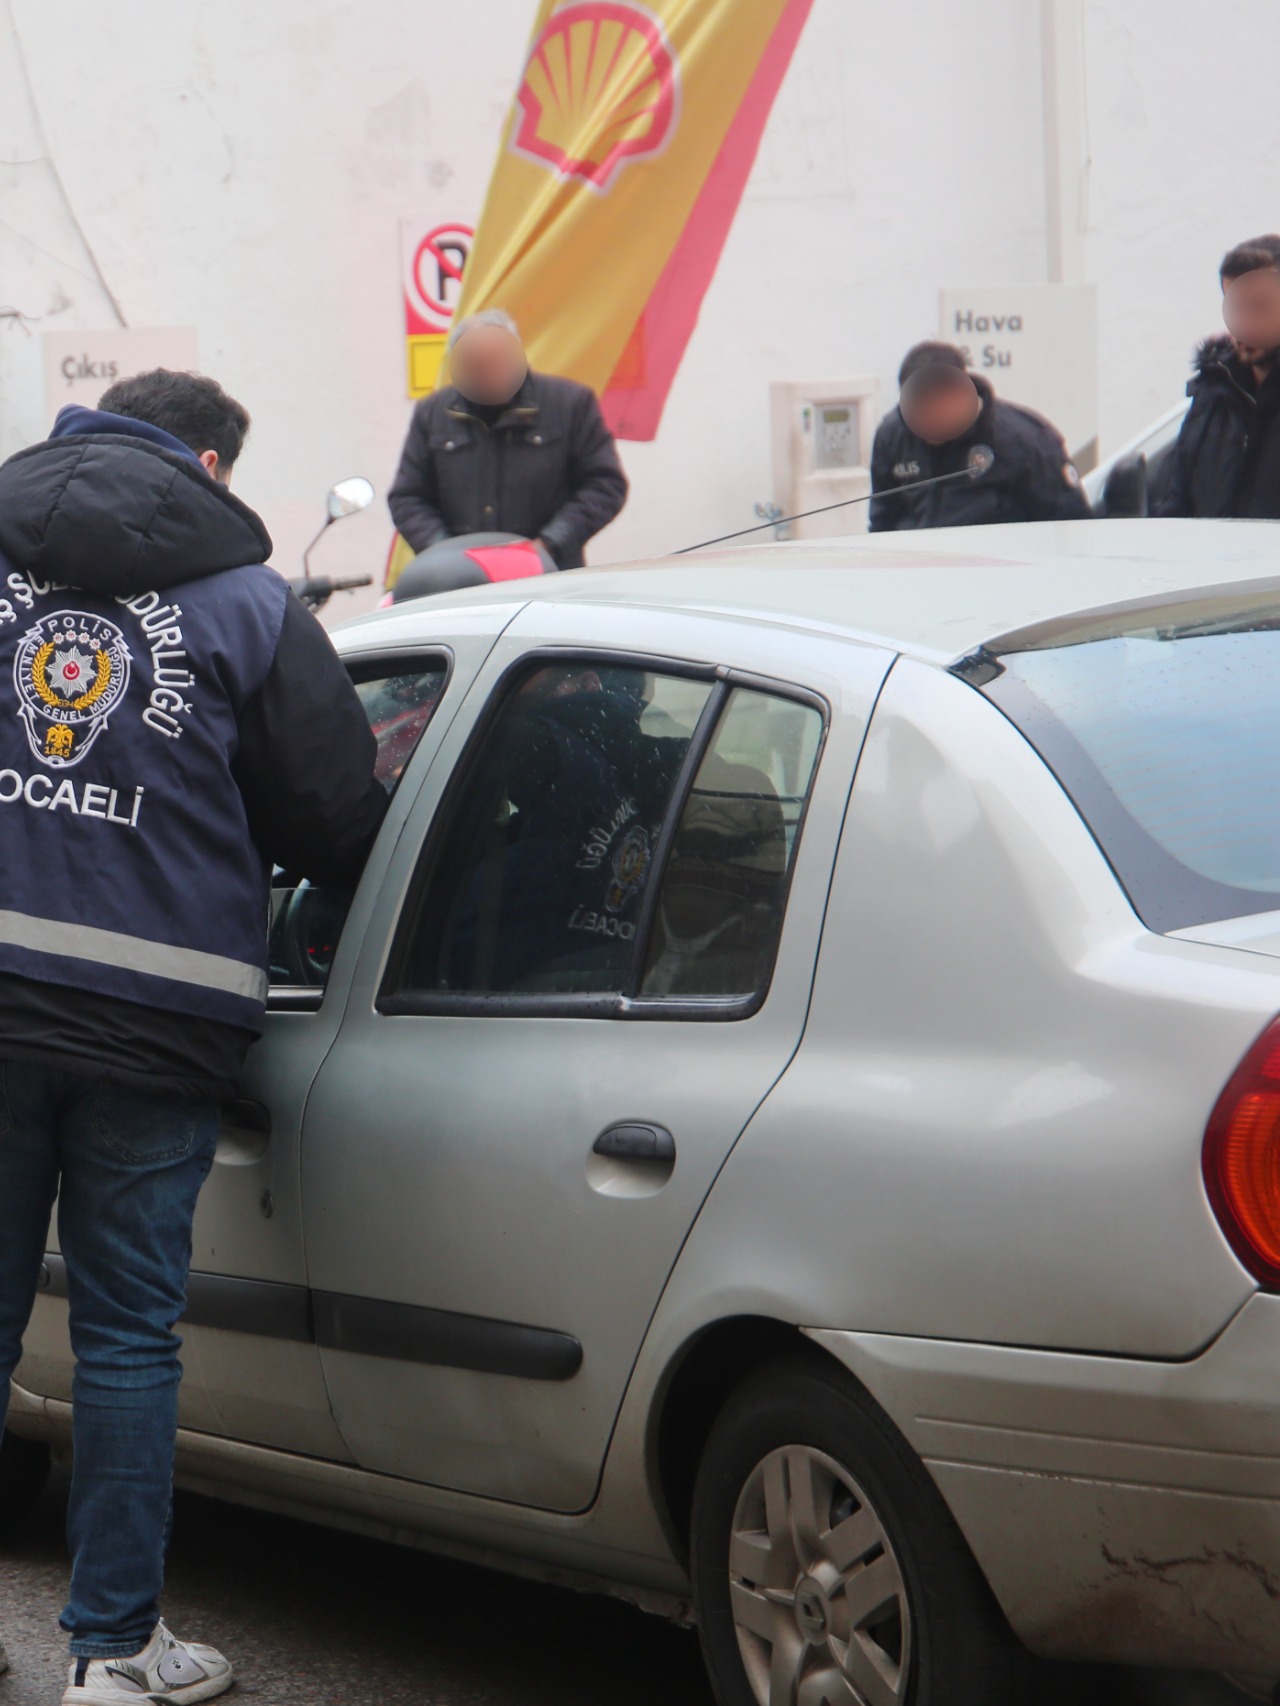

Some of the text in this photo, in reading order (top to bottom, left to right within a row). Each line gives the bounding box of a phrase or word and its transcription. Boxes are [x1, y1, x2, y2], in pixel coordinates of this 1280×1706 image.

[955, 309, 1023, 332] Hava
[982, 344, 1012, 367] Su
[61, 353, 119, 387] Çıkış
[47, 616, 112, 641] POLİS
[43, 704, 86, 721] GENEL
[44, 745, 70, 757] 1845
